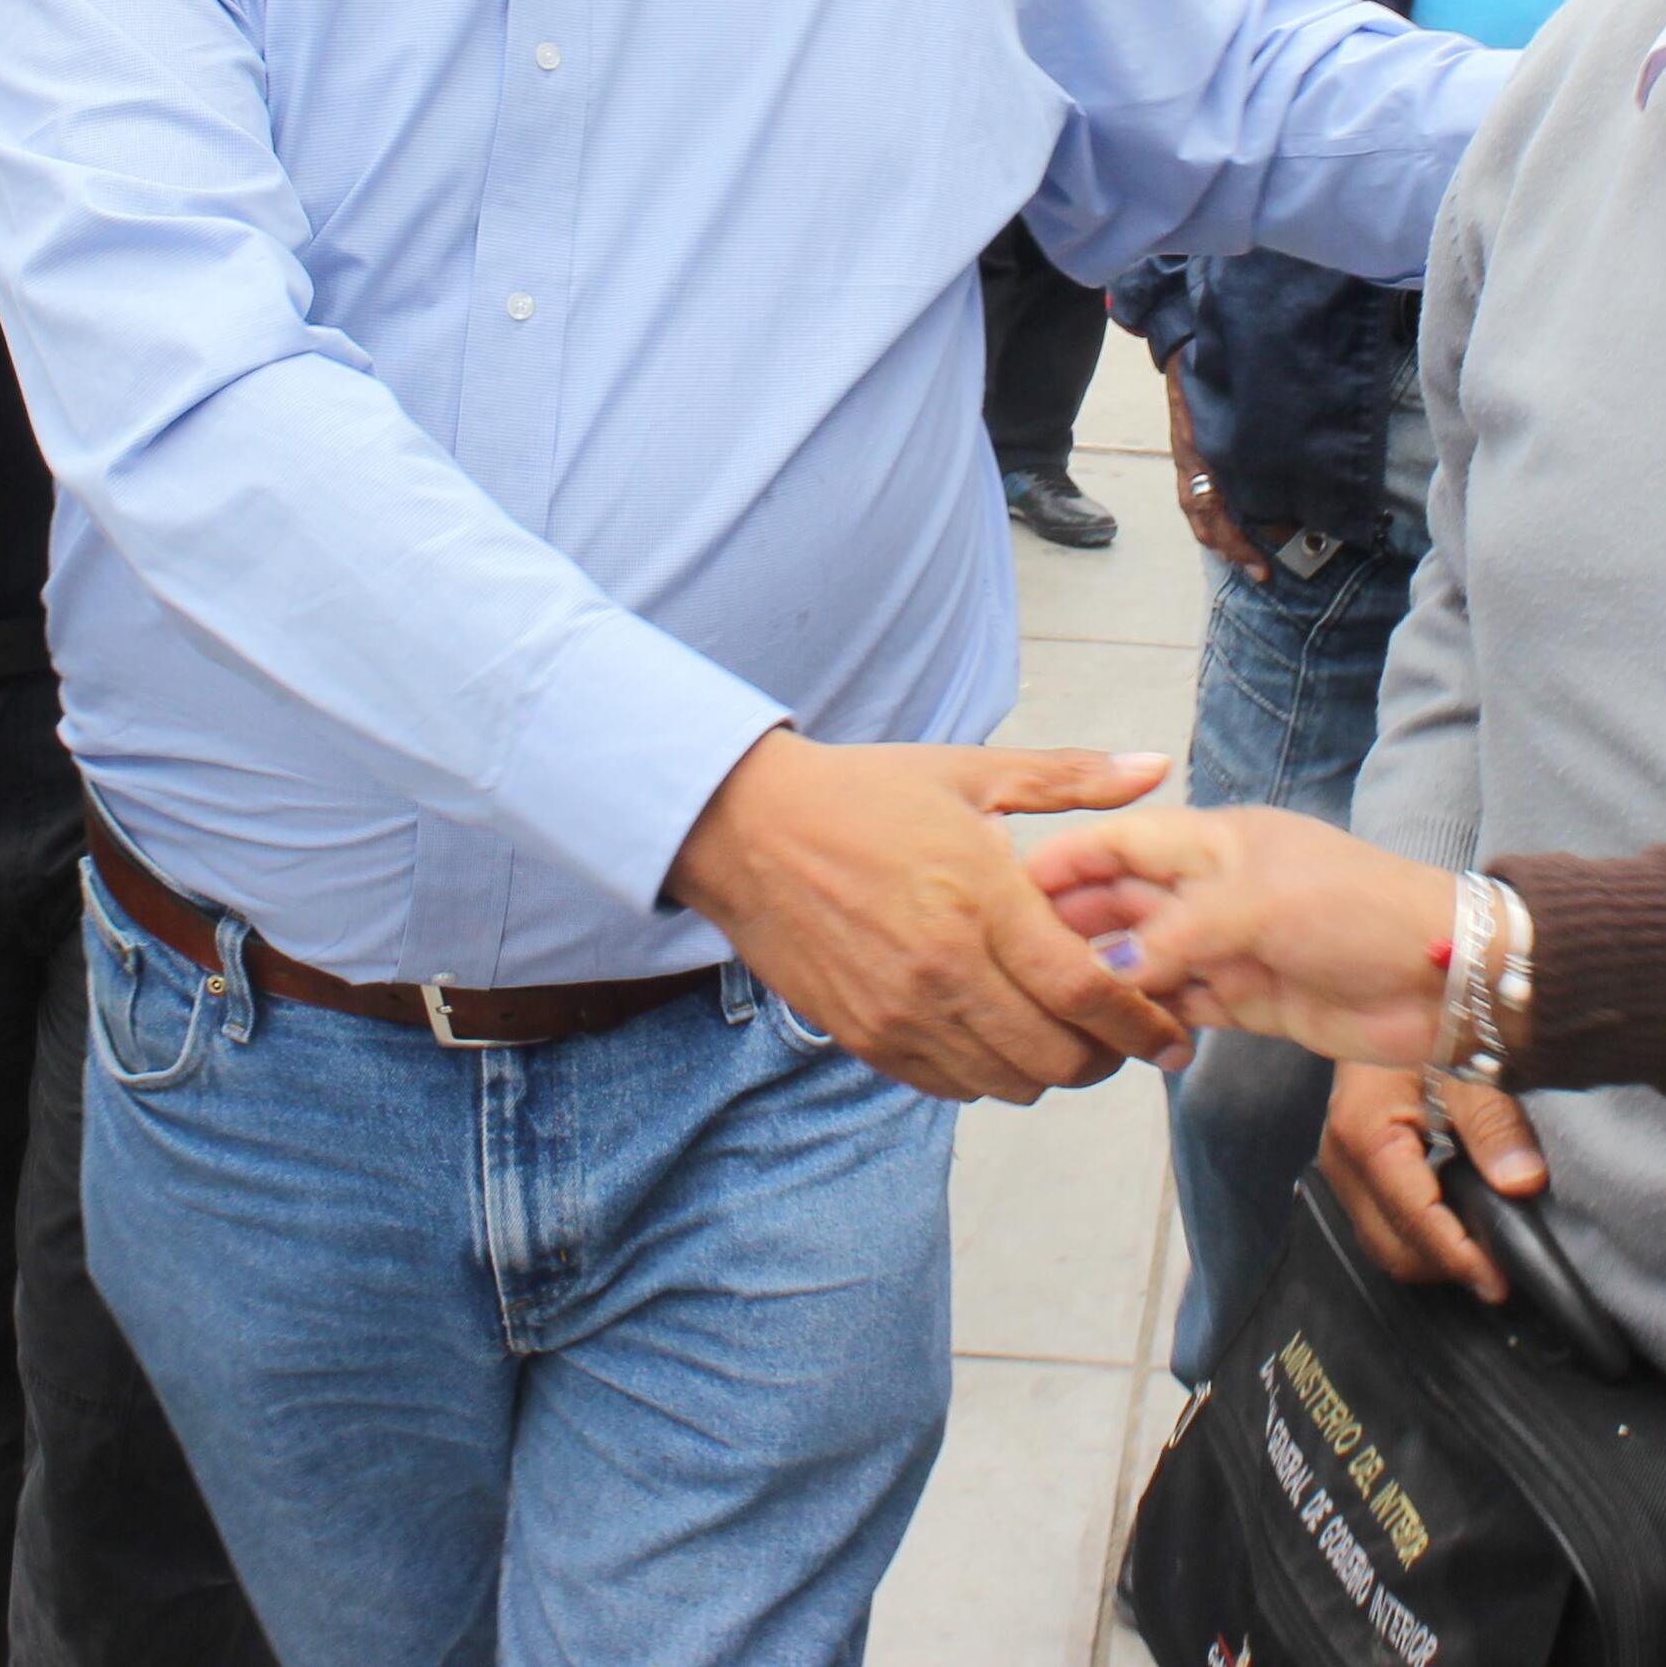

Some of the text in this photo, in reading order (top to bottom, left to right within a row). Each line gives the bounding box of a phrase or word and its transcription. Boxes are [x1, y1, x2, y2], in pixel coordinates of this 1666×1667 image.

[1279, 1330, 1363, 1457] MINISTERIO
[1347, 1444, 1385, 1501] DEL
[1267, 1417, 1314, 1509] GENERAL
[1300, 1488, 1334, 1535] DE
[1368, 1582, 1439, 1667] INTERIOR
